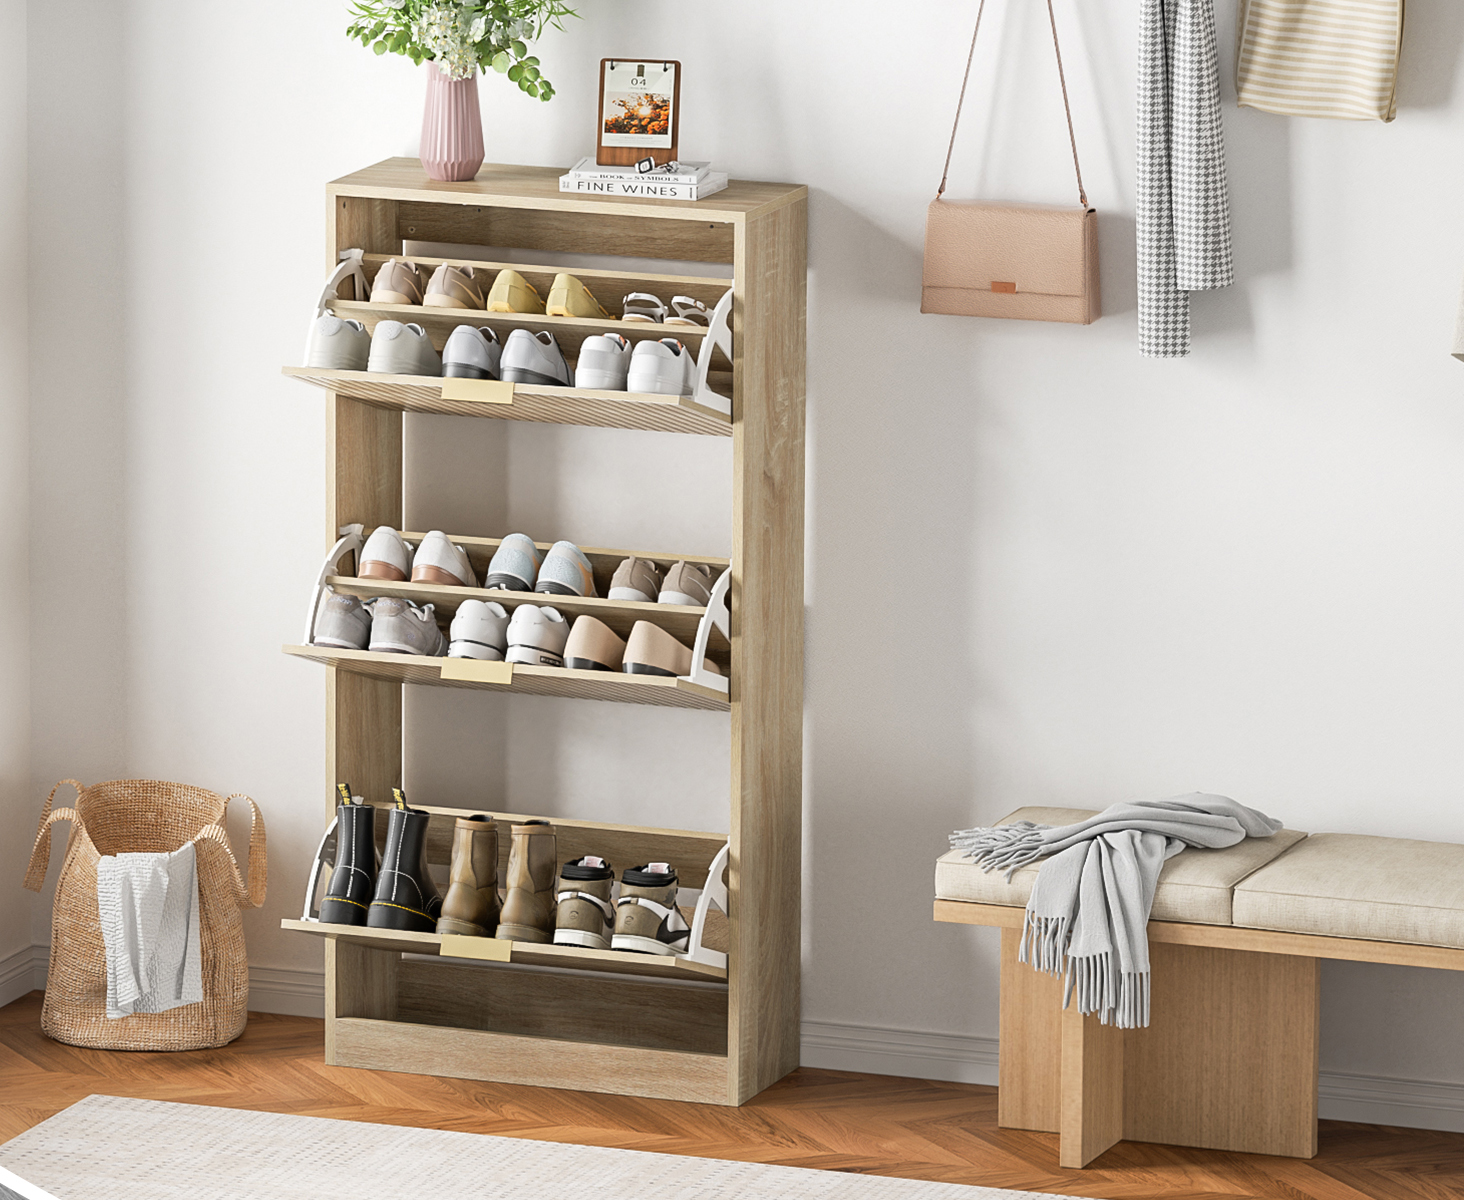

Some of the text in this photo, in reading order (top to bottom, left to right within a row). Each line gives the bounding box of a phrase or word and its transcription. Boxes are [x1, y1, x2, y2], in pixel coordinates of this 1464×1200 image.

[631, 78, 646, 86] 04
[577, 181, 614, 192] FINE
[622, 184, 678, 197] WINES
